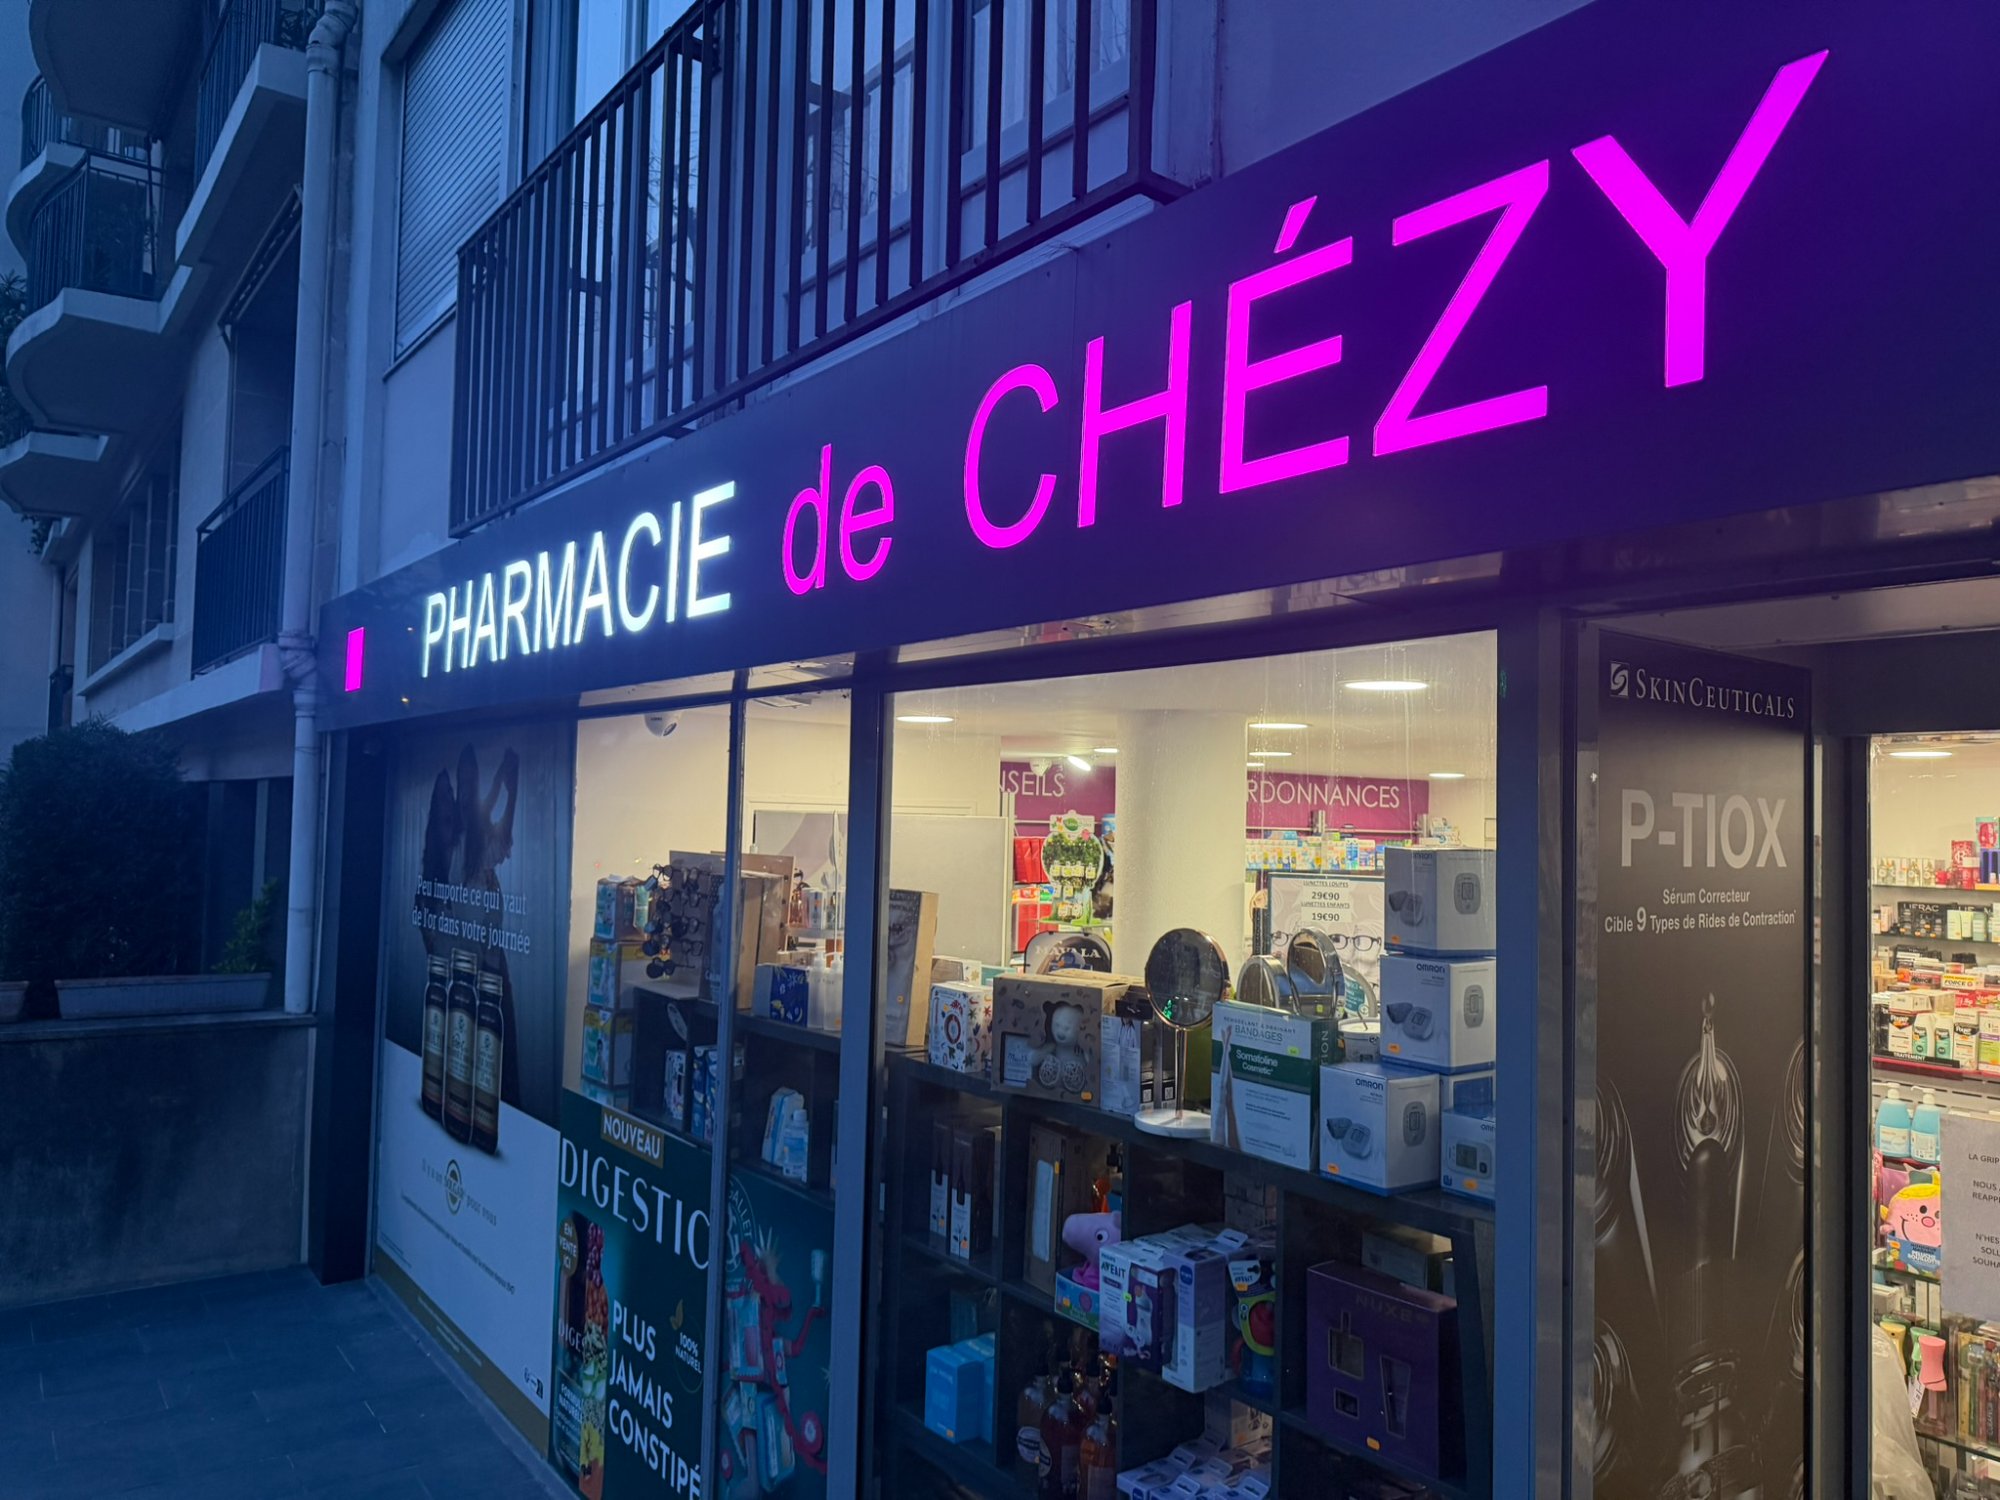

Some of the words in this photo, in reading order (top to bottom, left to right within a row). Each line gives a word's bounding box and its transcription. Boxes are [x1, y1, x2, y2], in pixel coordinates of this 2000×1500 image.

[423, 481, 735, 677] PHARMACIE
[783, 446, 894, 595] de
[965, 50, 1828, 548] CHÉZY
[1621, 788, 1787, 869] P-TIOX
[416, 874, 432, 897] Peu
[434, 878, 469, 904] importe
[470, 889, 482, 907] ce
[484, 888, 501, 913] qui
[502, 893, 527, 916] vaut
[1311, 891, 1340, 901] 29€90
[1662, 887, 1696, 904] Sérum
[1698, 888, 1751, 904] Correcteur
[411, 905, 422, 927] de
[438, 910, 459, 936] dans
[461, 919, 486, 943] votre
[488, 923, 531, 954] journée
[1312, 912, 1340, 921] 19€90
[1604, 916, 1634, 933] Cible
[1636, 906, 1647, 931] 9
[1650, 914, 1680, 934] Types
[1682, 913, 1696, 929] de
[1698, 912, 1726, 928] Rides
[1728, 911, 1740, 927] de
[1235, 1025, 1283, 1042] BANDAGES
[1236, 1050, 1279, 1068] Somatoline
[603, 1114, 661, 1160] NOUVEAU
[1968, 1153, 1979, 1161] LA
[1973, 1180, 1998, 1191] NOUS
[613, 1299, 657, 1362] PLUS
[680, 1332, 699, 1358] 100%
[675, 1344, 702, 1374] NATUREL
[609, 1348, 674, 1429] JAMAIS
[609, 1399, 702, 1500] CONSTIPÉ
